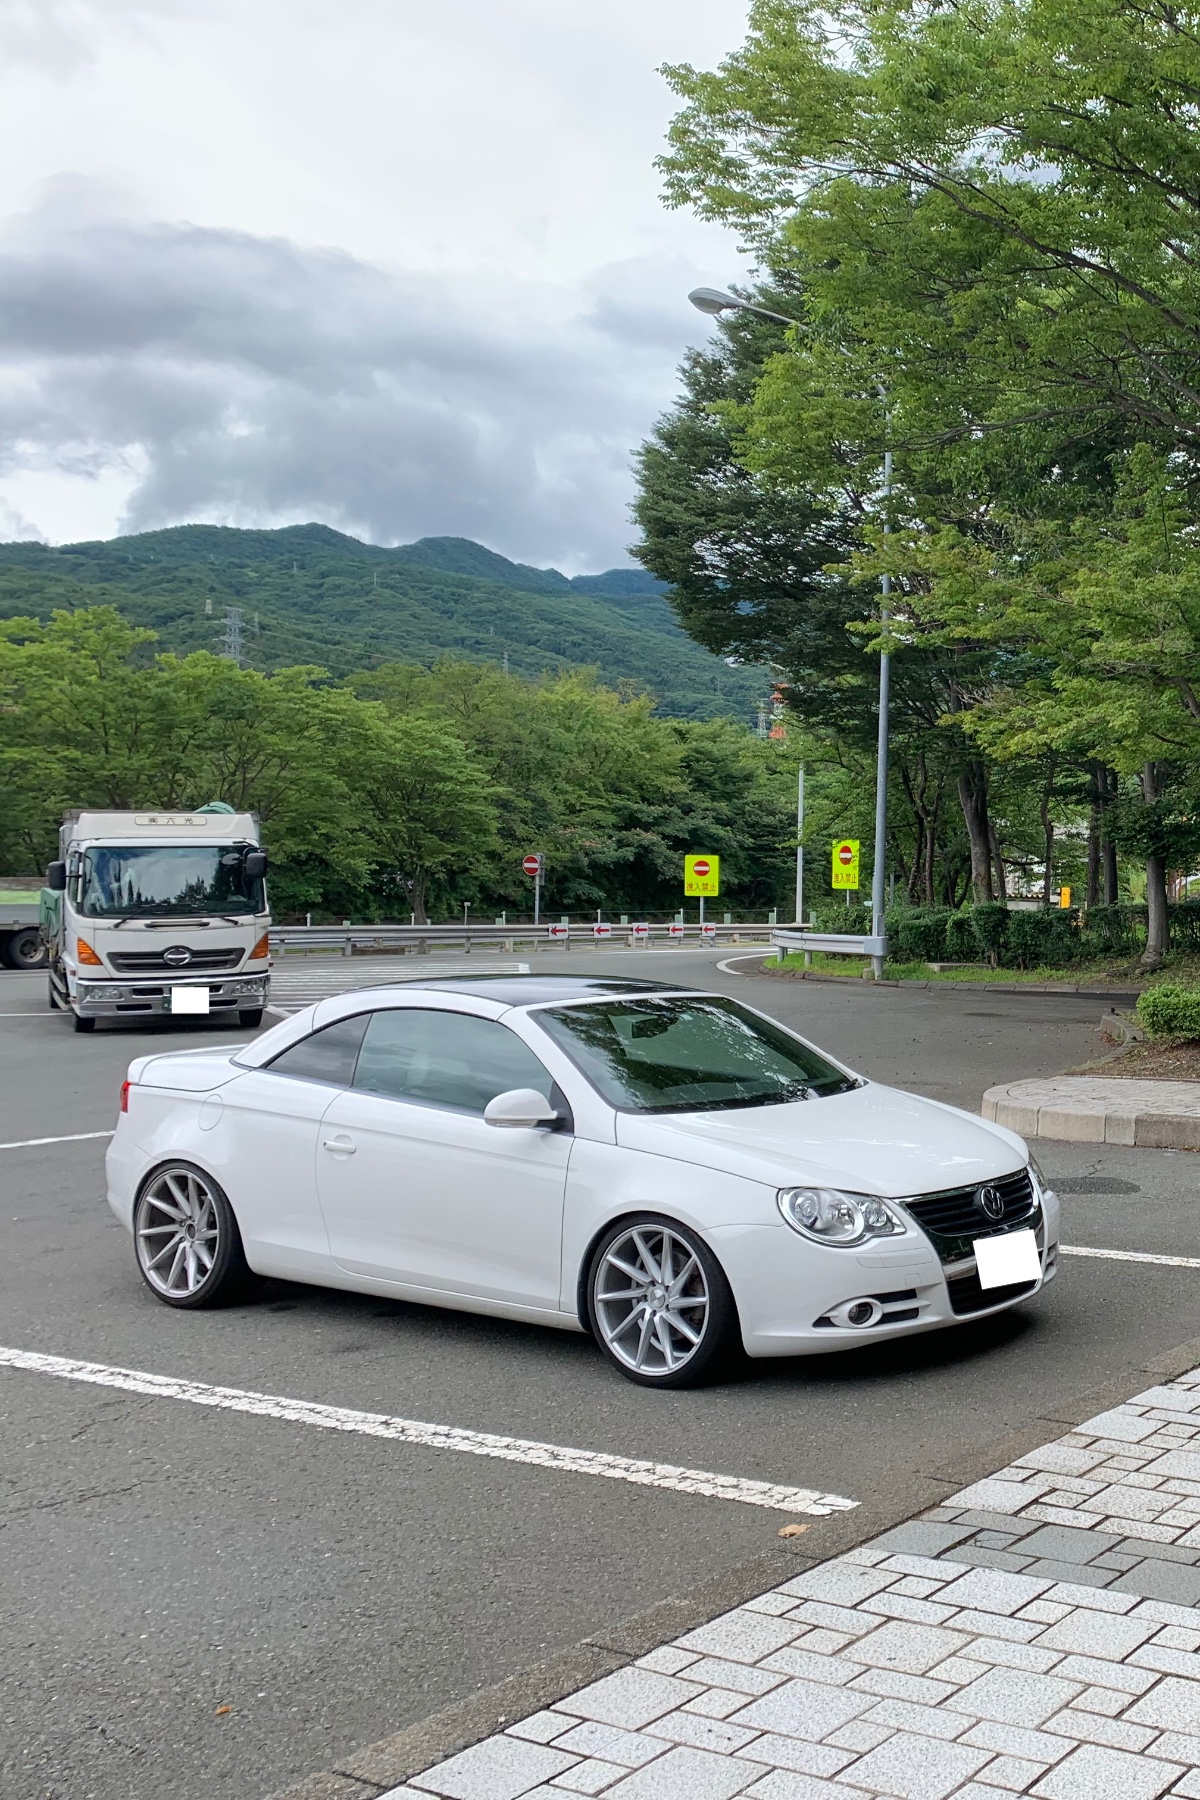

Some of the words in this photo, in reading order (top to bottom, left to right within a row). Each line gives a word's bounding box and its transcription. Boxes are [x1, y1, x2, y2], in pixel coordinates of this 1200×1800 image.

[833, 873, 857, 883] 進入禁止
[686, 882, 717, 892] 進入禁止
